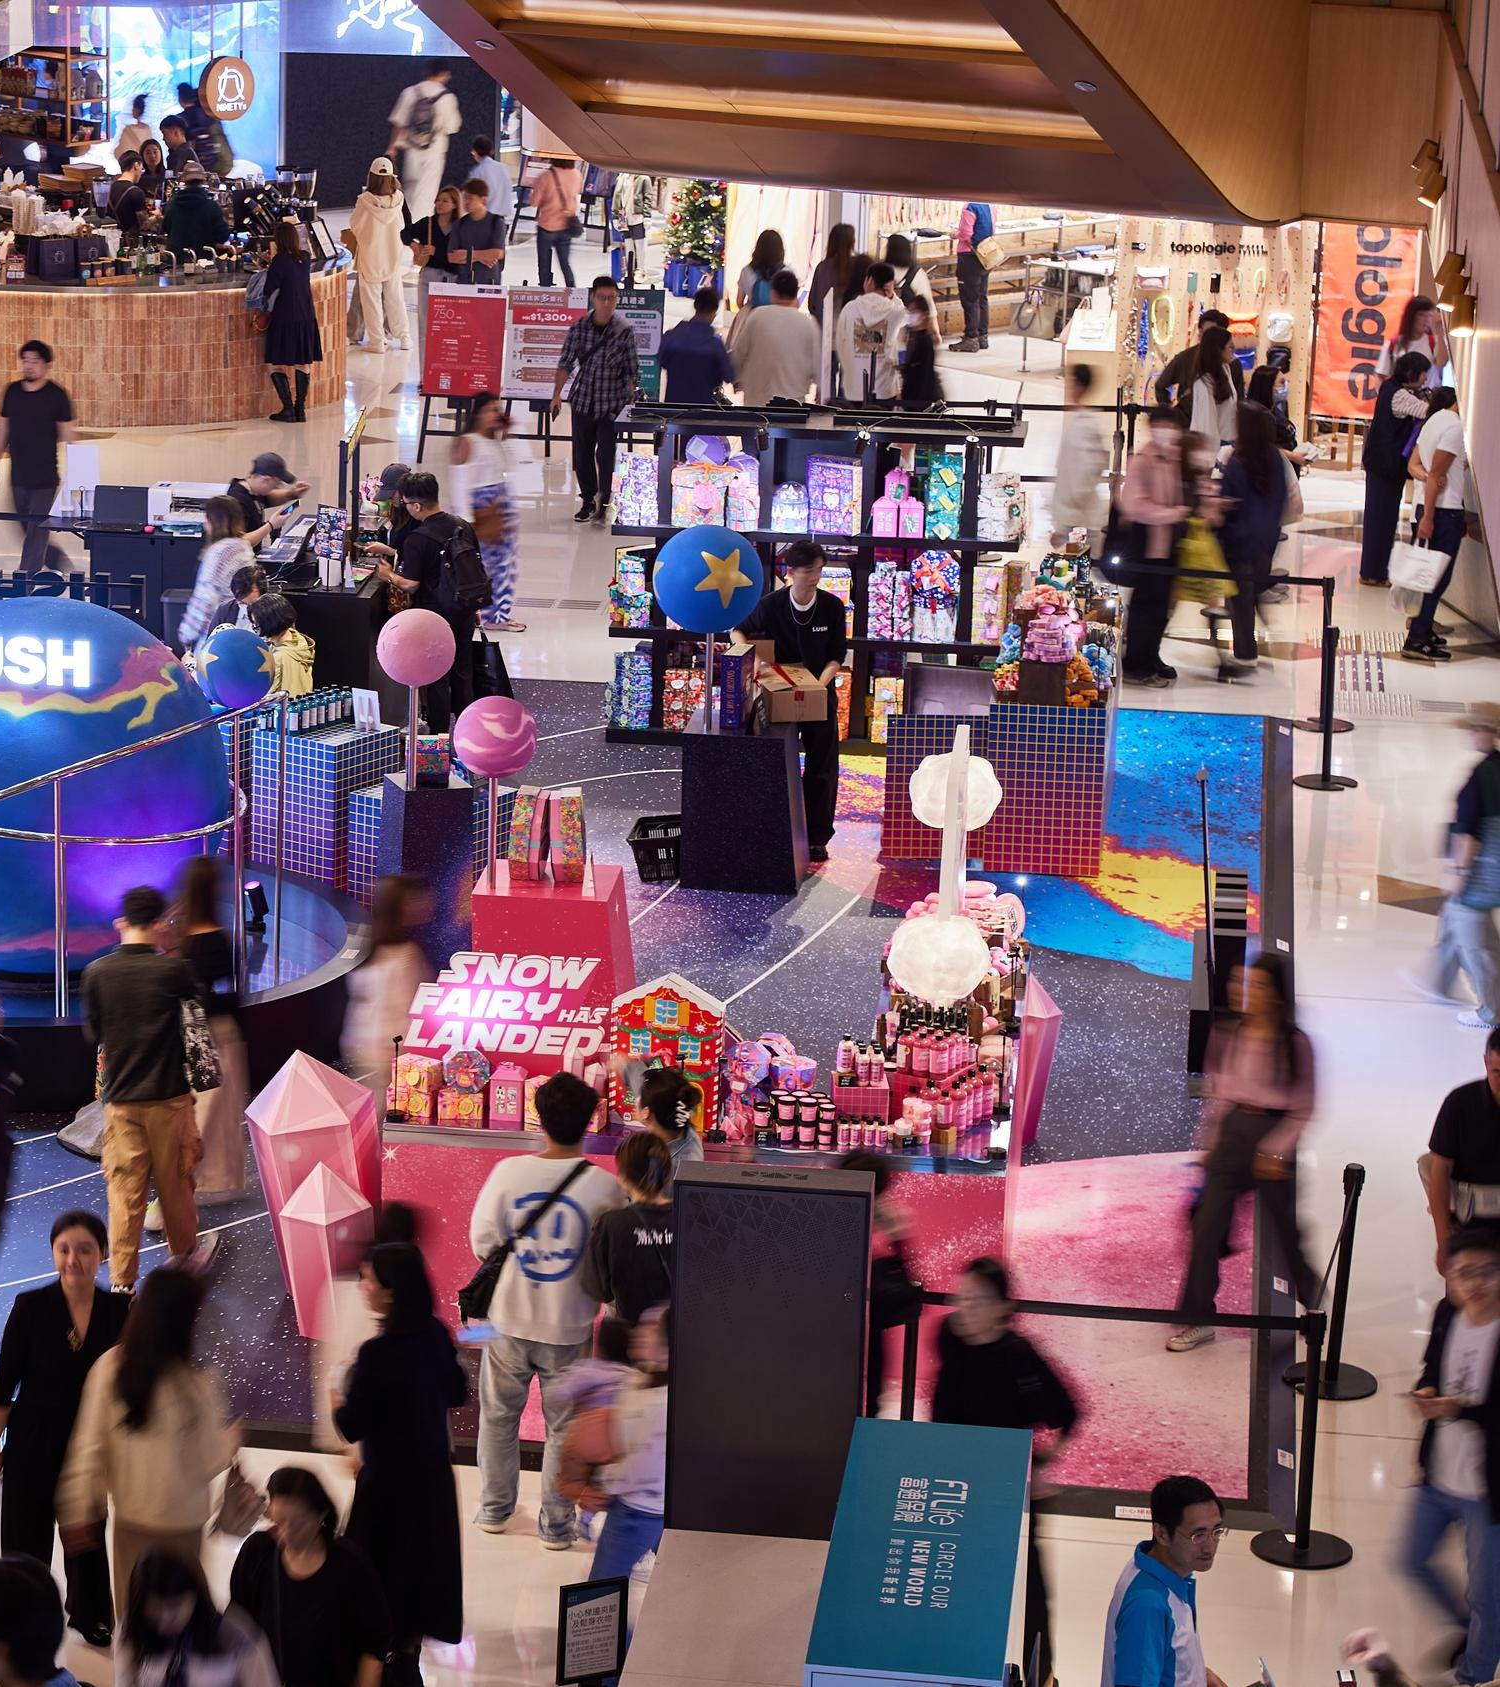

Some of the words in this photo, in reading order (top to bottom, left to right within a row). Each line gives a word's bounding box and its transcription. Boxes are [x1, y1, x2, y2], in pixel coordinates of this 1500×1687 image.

[1170, 241, 1236, 256] topologie
[433, 308, 455, 319] 750
[436, 951, 601, 990] SNOW
[408, 982, 563, 1021] FAIRY
[556, 1006, 609, 1024] HAS
[402, 1017, 606, 1057] LANDED
[893, 1477, 931, 1523] 富通保險
[928, 1479, 969, 1526] FTLife
[910, 1539, 932, 1565] NEW
[933, 1542, 957, 1581] CIRCLE
[903, 1567, 927, 1607] WORLD
[929, 1585, 951, 1609] OUR
